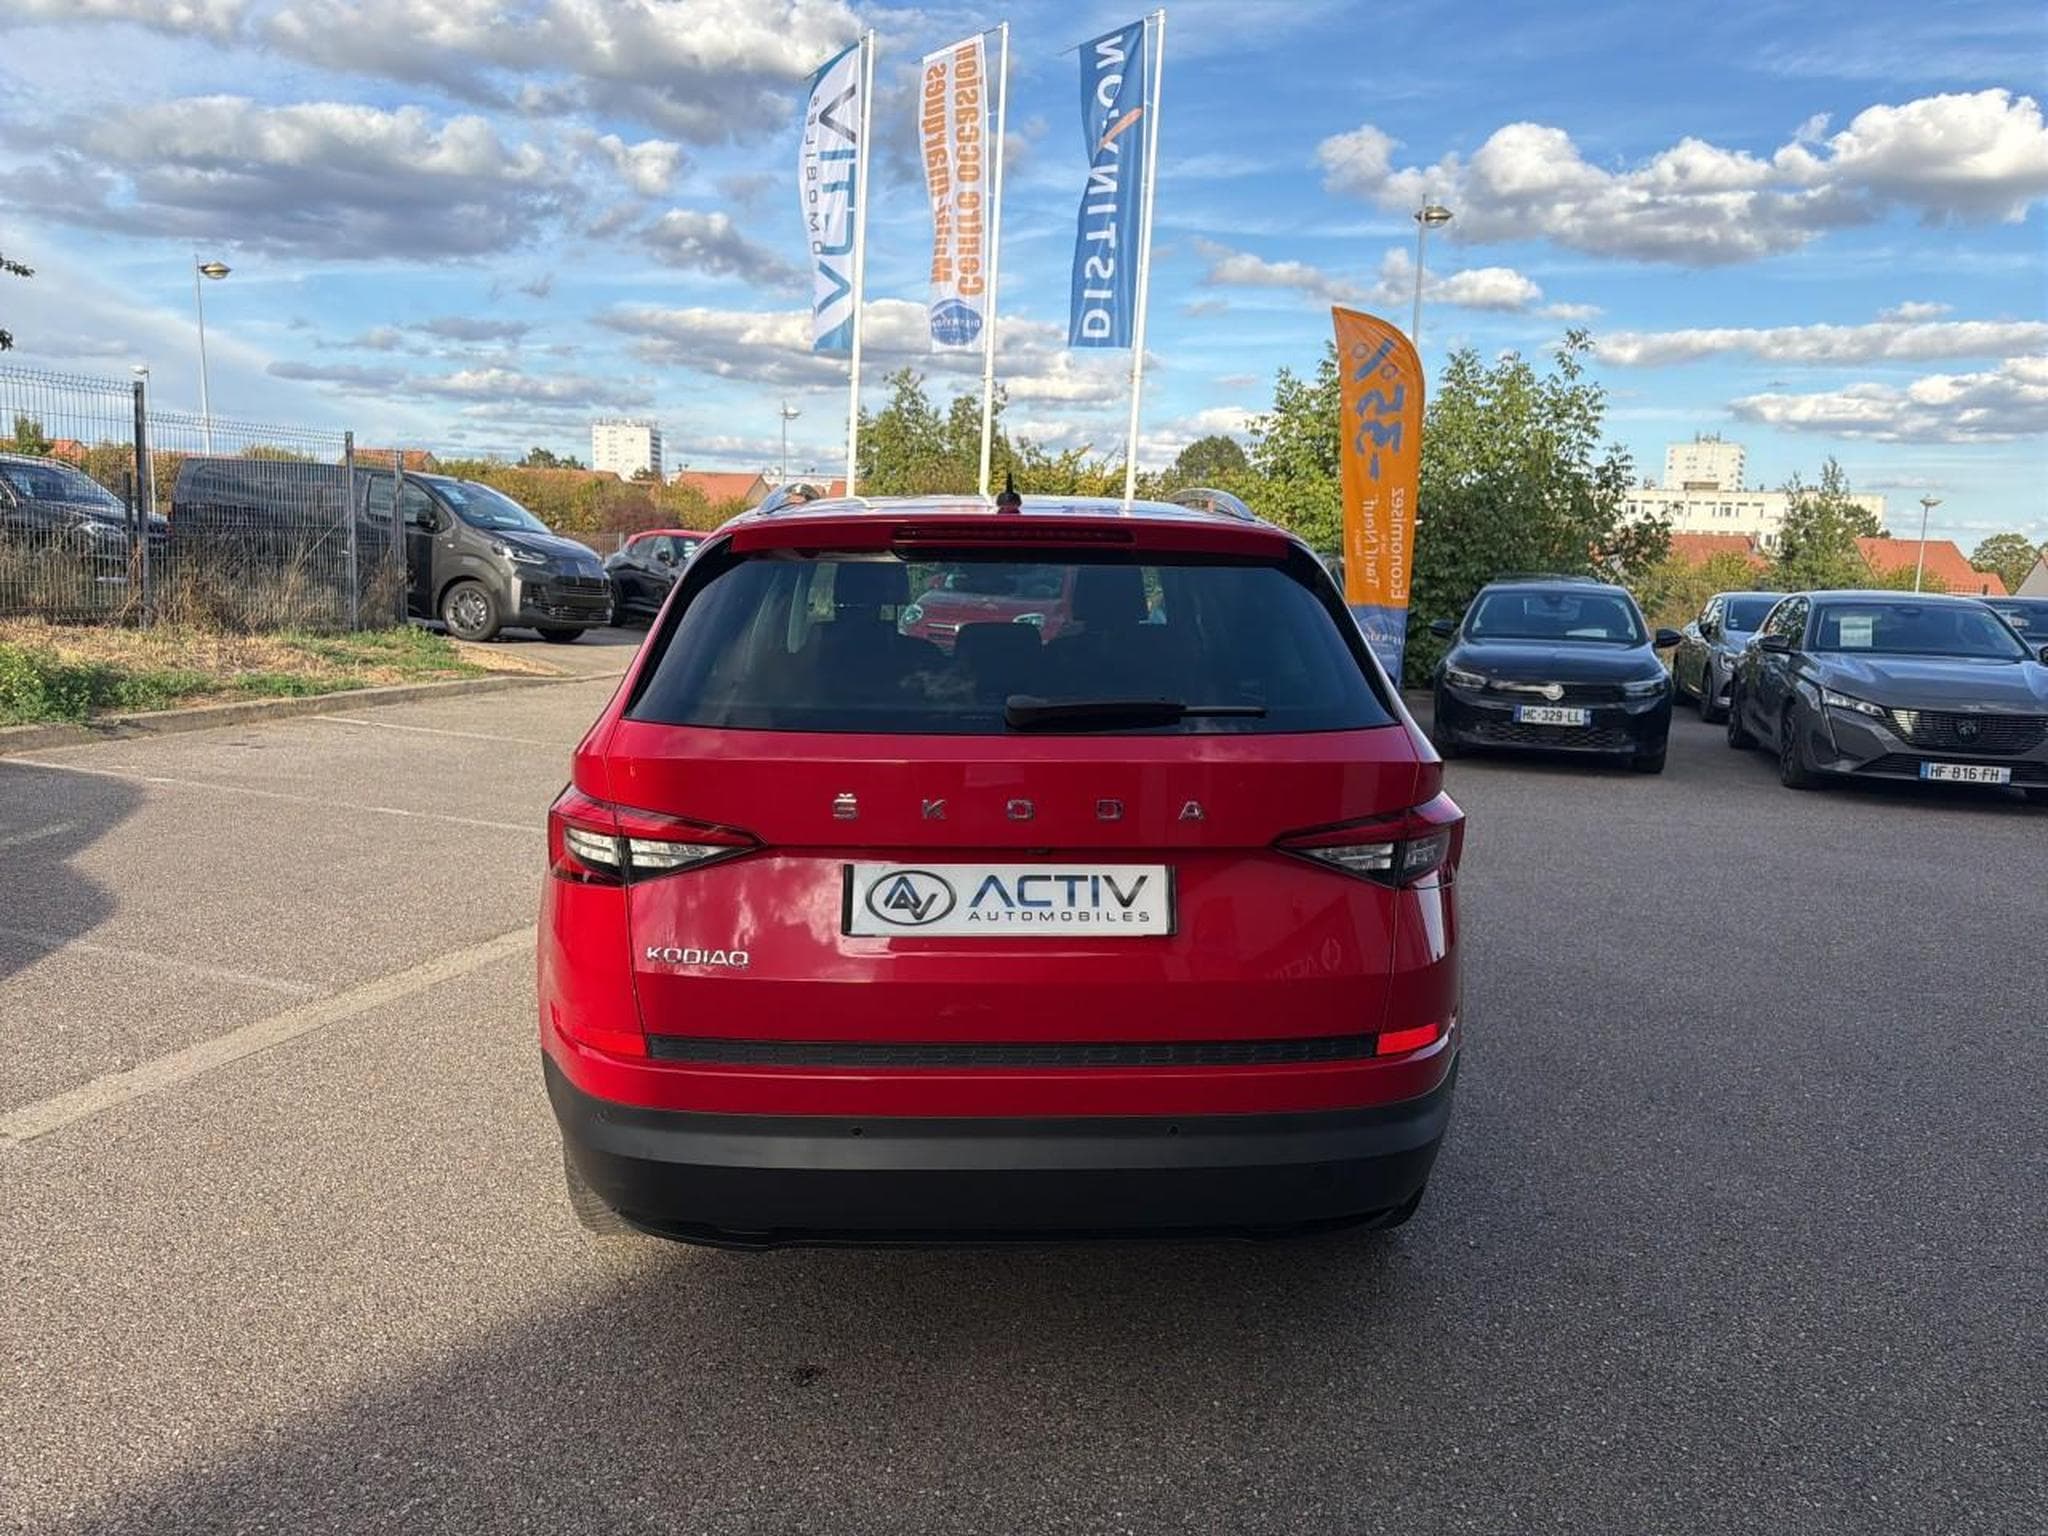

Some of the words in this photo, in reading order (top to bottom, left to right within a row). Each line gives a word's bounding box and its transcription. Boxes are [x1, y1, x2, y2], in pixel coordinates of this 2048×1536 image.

[833, 793, 1204, 820] ŠKODA
[968, 874, 1149, 908] ACTIV
[967, 910, 1150, 923] AUTOMOBILES
[646, 946, 750, 968] KODIAQ
